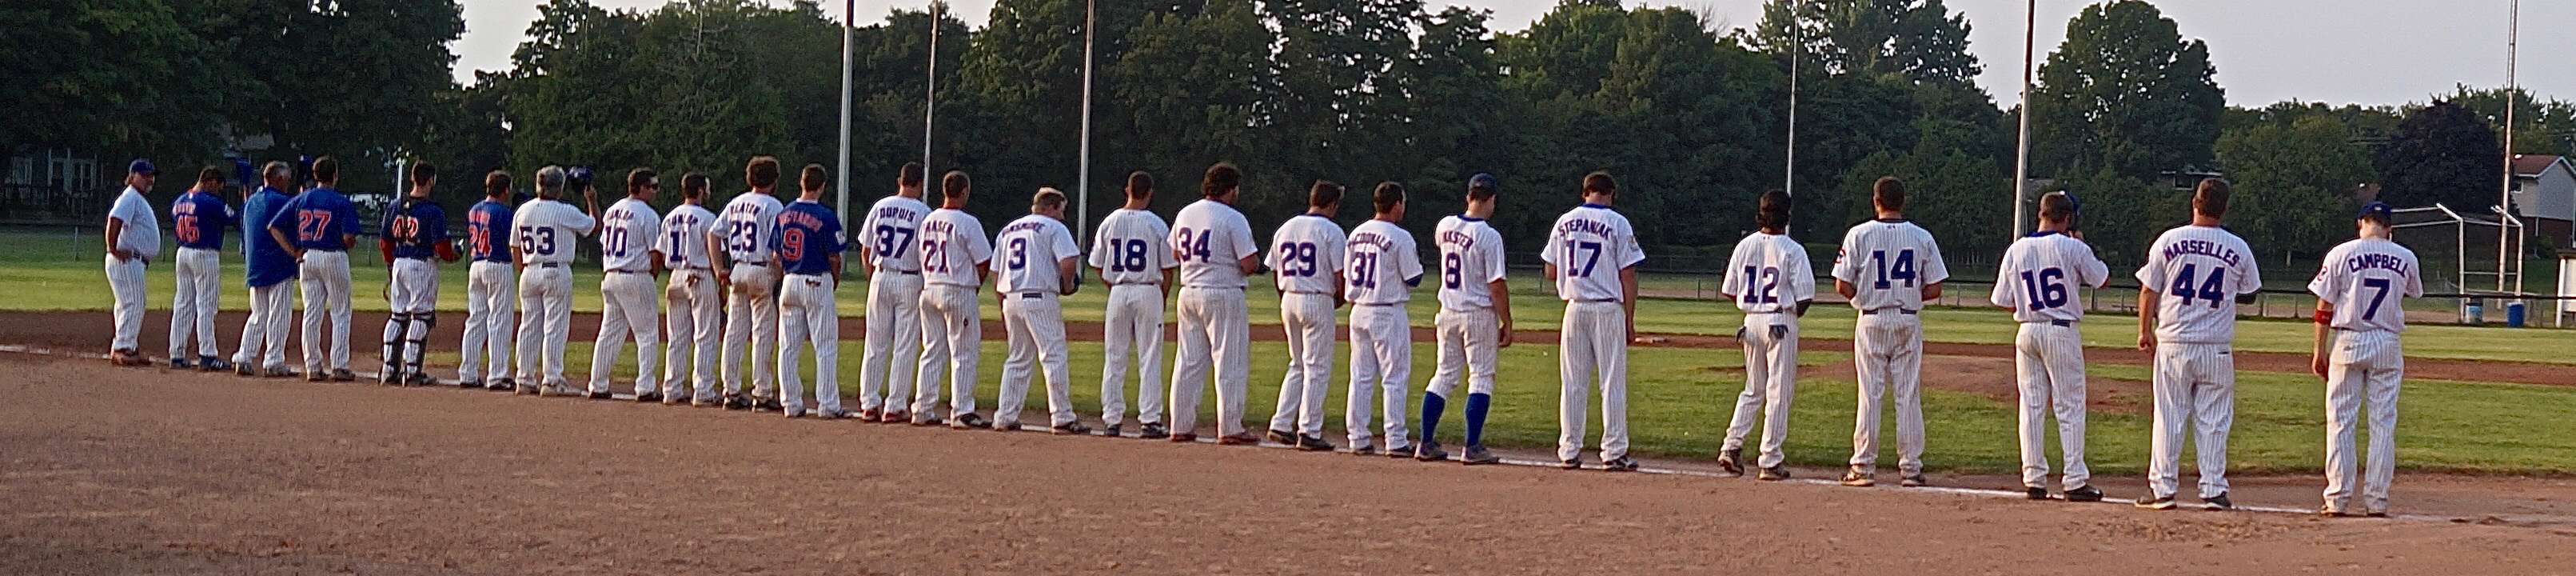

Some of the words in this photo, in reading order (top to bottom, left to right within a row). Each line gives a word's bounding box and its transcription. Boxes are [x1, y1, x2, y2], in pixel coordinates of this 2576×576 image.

[298, 209, 332, 242] 27
[392, 214, 420, 246] 42
[879, 206, 916, 223] DUPUIS
[1558, 218, 1613, 241] STEPANIAK
[520, 226, 556, 255] 53
[604, 226, 628, 258] 10
[731, 221, 757, 253] 23
[783, 227, 805, 262] 9
[875, 225, 915, 259] 37
[1008, 238, 1027, 270] 3
[1178, 226, 1212, 264] 34
[2163, 239, 2240, 268] MARSEILLES
[922, 239, 949, 274] 21
[1110, 238, 1147, 273] 18
[1280, 242, 1317, 278] 29
[1350, 251, 1377, 290] 31
[1445, 253, 1461, 290] 8
[1565, 238, 1602, 278] 17
[1872, 249, 1916, 290] 14
[2348, 253, 2409, 278] CAMPBELL
[1744, 265, 1780, 304] 12
[2021, 266, 2068, 311] 16
[2171, 263, 2225, 309] 44
[2362, 278, 2391, 322] 7
